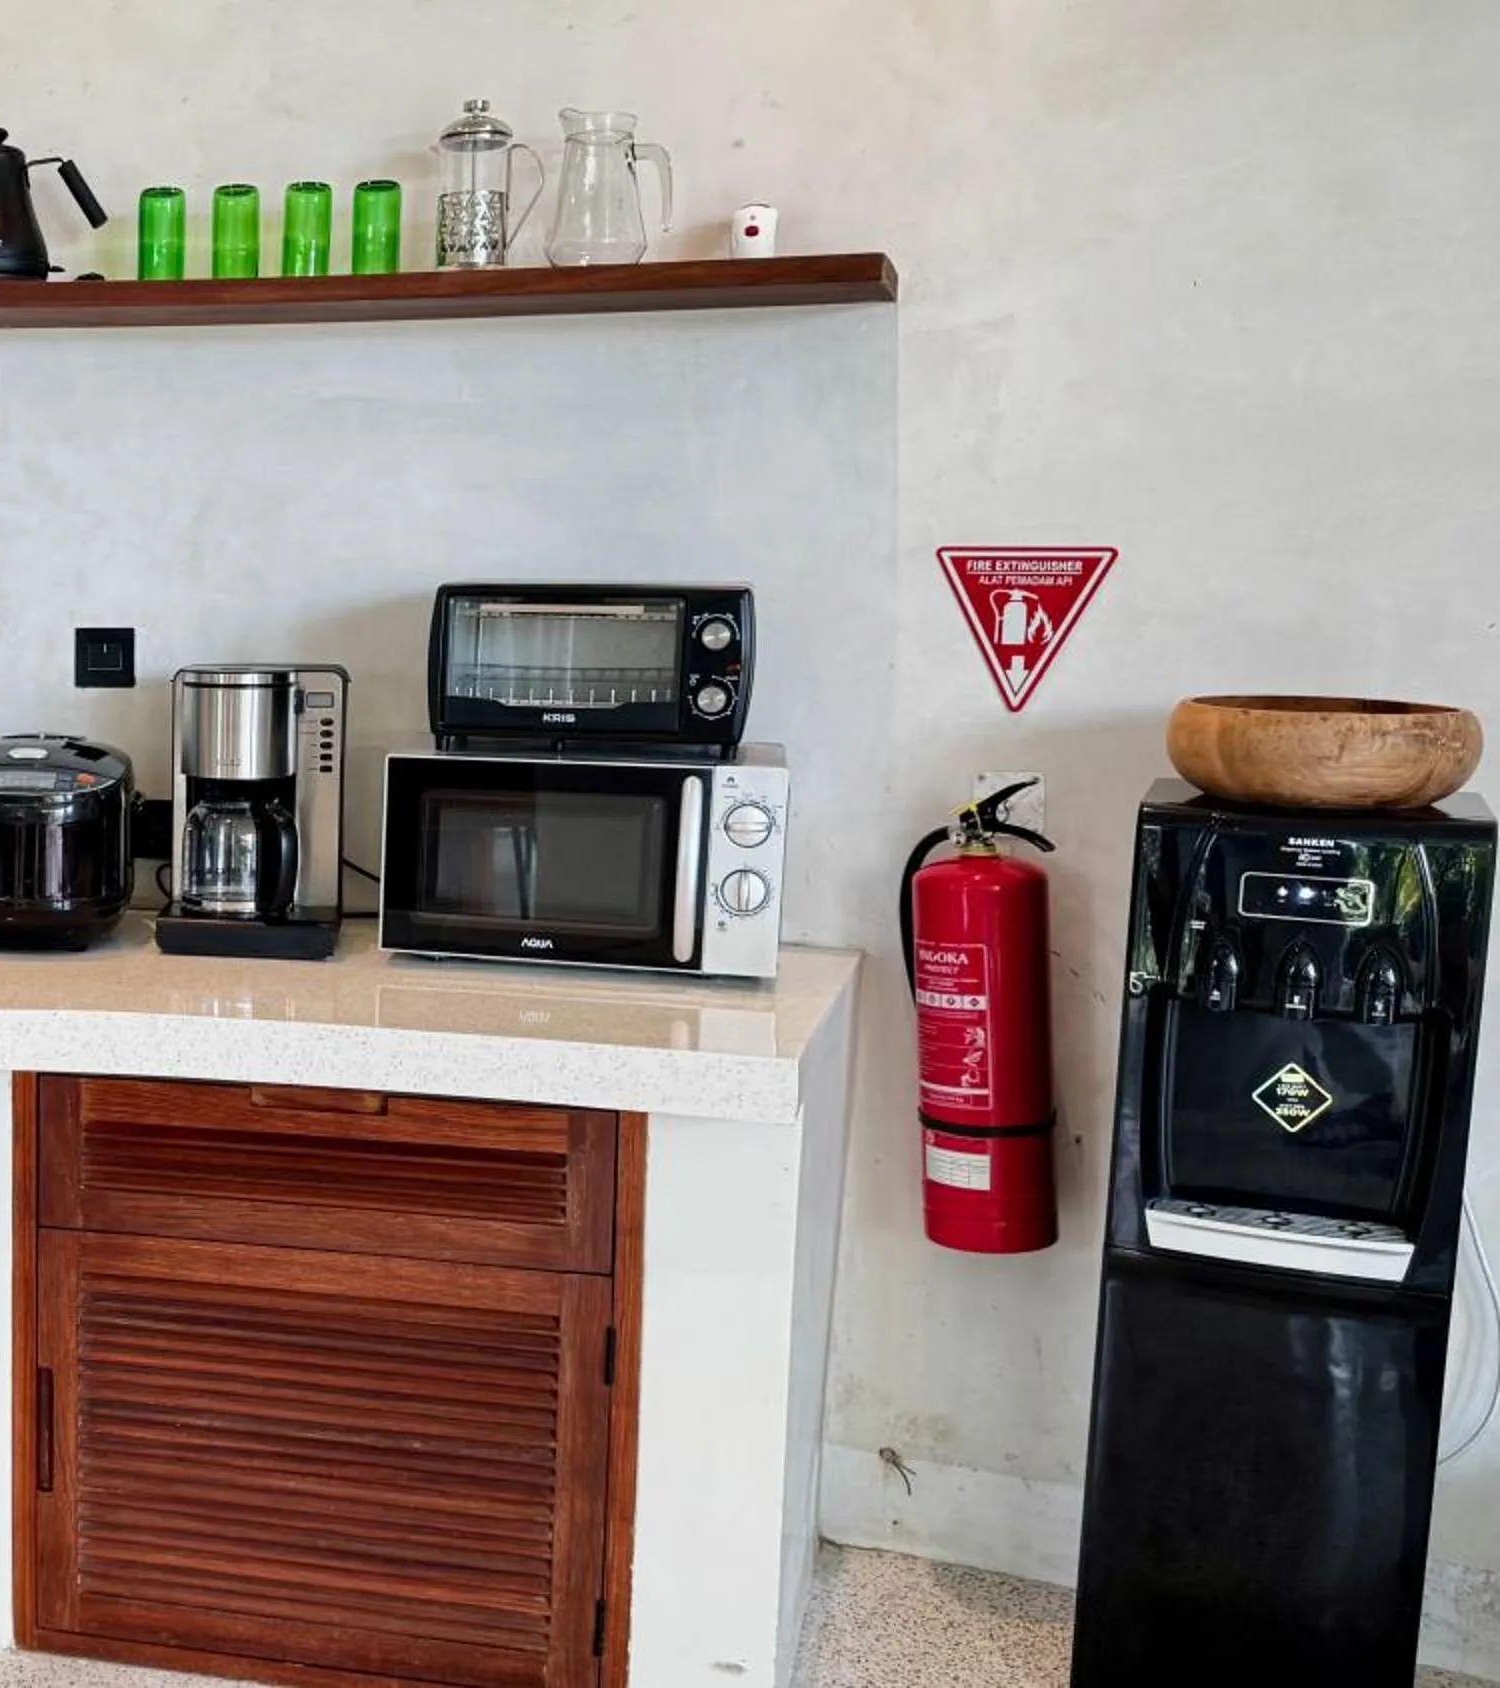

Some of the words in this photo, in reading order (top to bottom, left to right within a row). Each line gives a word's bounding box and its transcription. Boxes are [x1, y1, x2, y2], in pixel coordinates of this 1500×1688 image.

[966, 560, 993, 571] FIRE
[995, 560, 1083, 572] EXTINGUISHER
[979, 575, 1003, 585] ALAT
[1056, 575, 1073, 587] API
[543, 712, 576, 723] KRIS
[1288, 837, 1335, 847] SANKEN
[521, 937, 553, 949] AQUA
